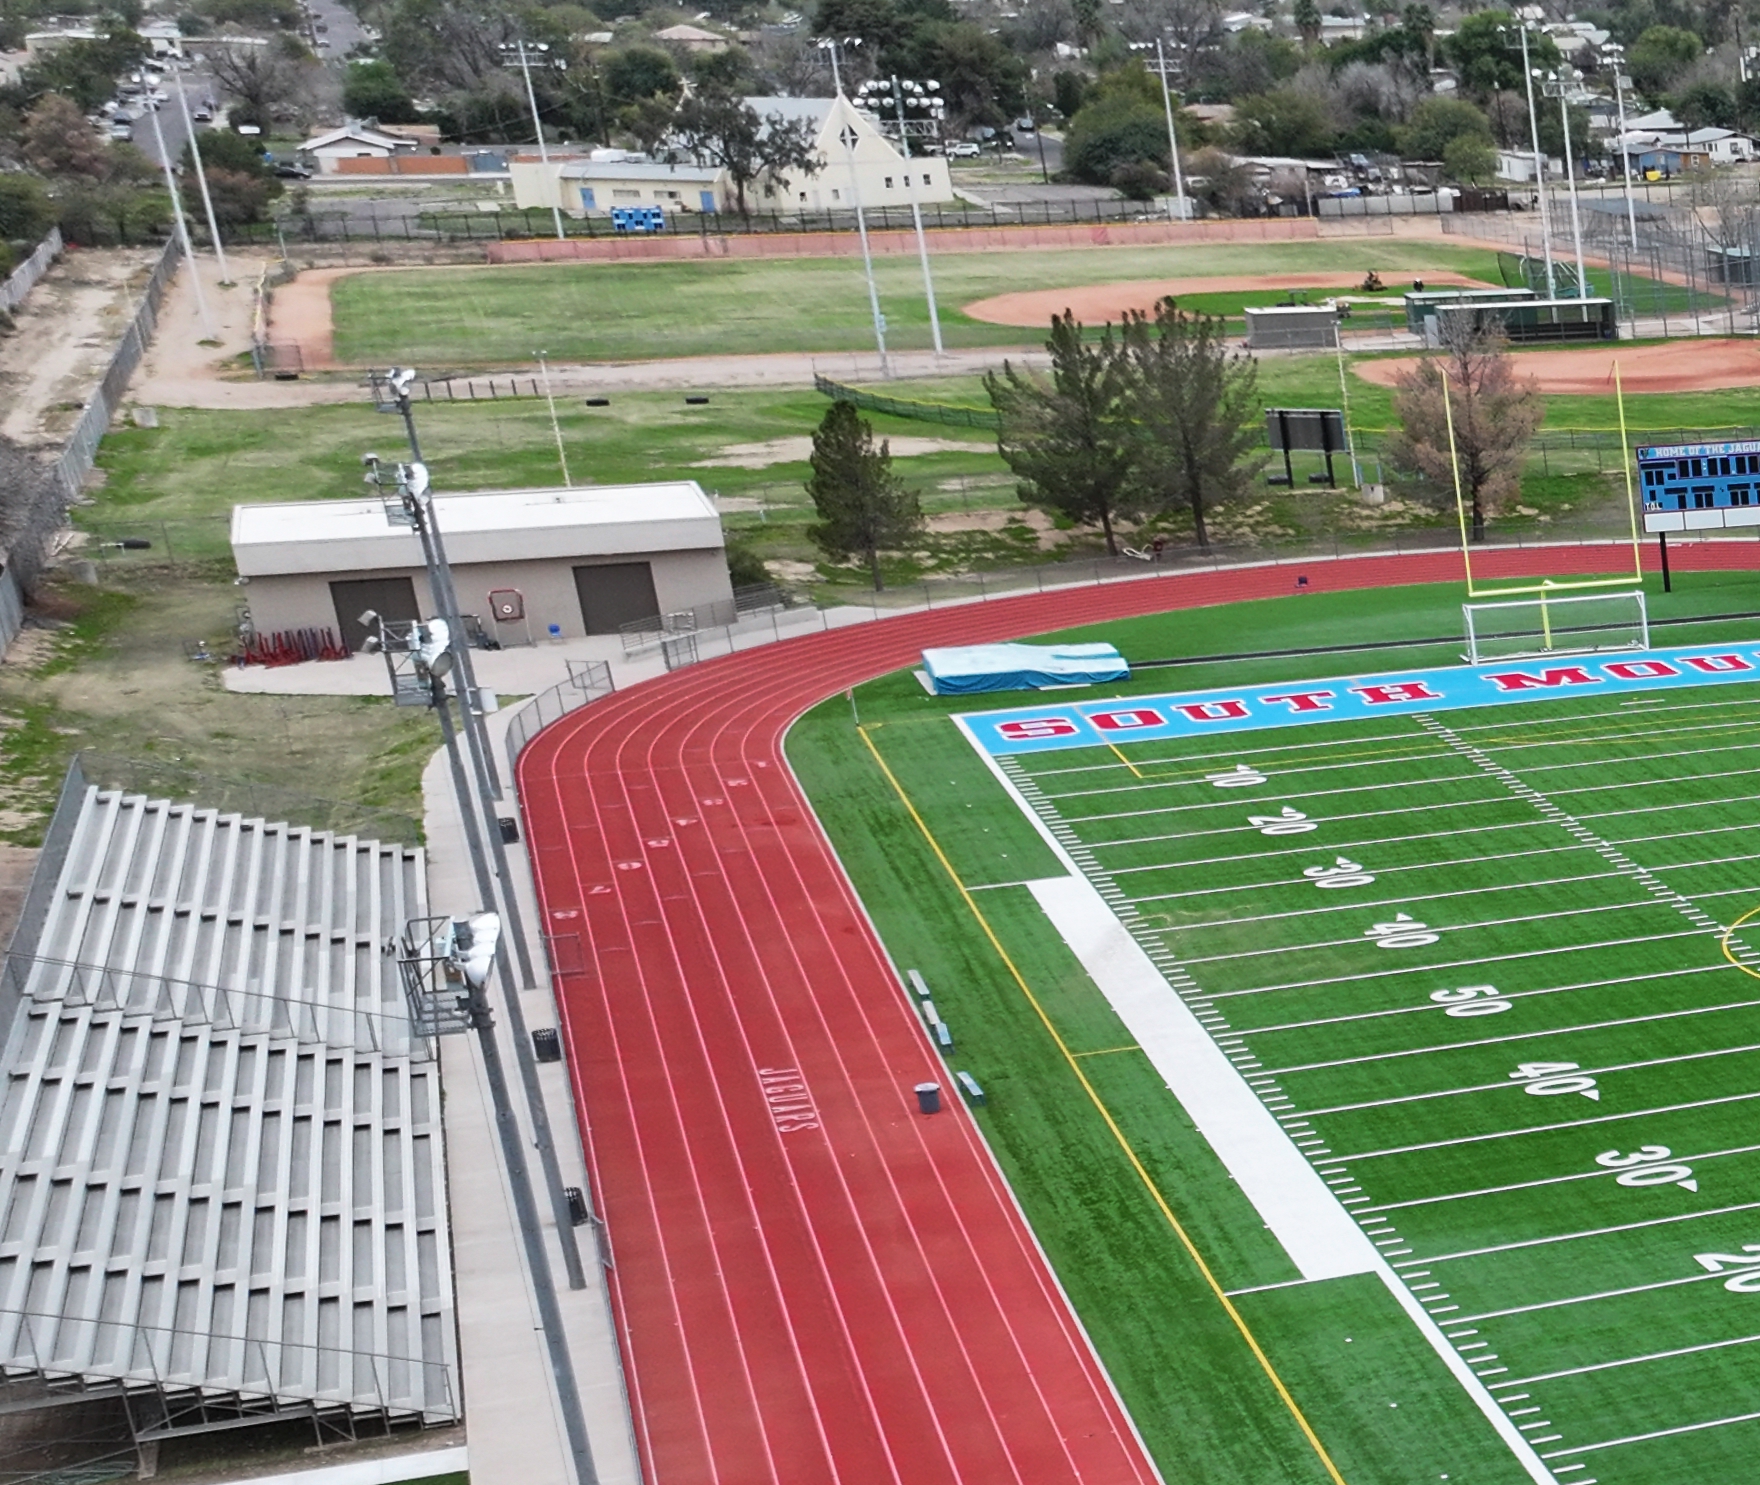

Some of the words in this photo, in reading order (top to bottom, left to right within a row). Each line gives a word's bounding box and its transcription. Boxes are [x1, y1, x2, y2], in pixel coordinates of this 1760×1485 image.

[1656, 447, 1685, 457] HOME
[1688, 445, 1702, 455] OF
[1705, 444, 1725, 454] THE
[995, 681, 1443, 742] SOUTH
[1205, 769, 1267, 788] 10
[1247, 812, 1318, 835] 20
[1303, 863, 1375, 889] 30
[1364, 922, 1439, 948] 40
[1430, 984, 1512, 1017] 50
[1509, 1062, 1596, 1096] 40
[758, 1068, 819, 1132] JAGUARS
[1595, 1145, 1692, 1186] 30
